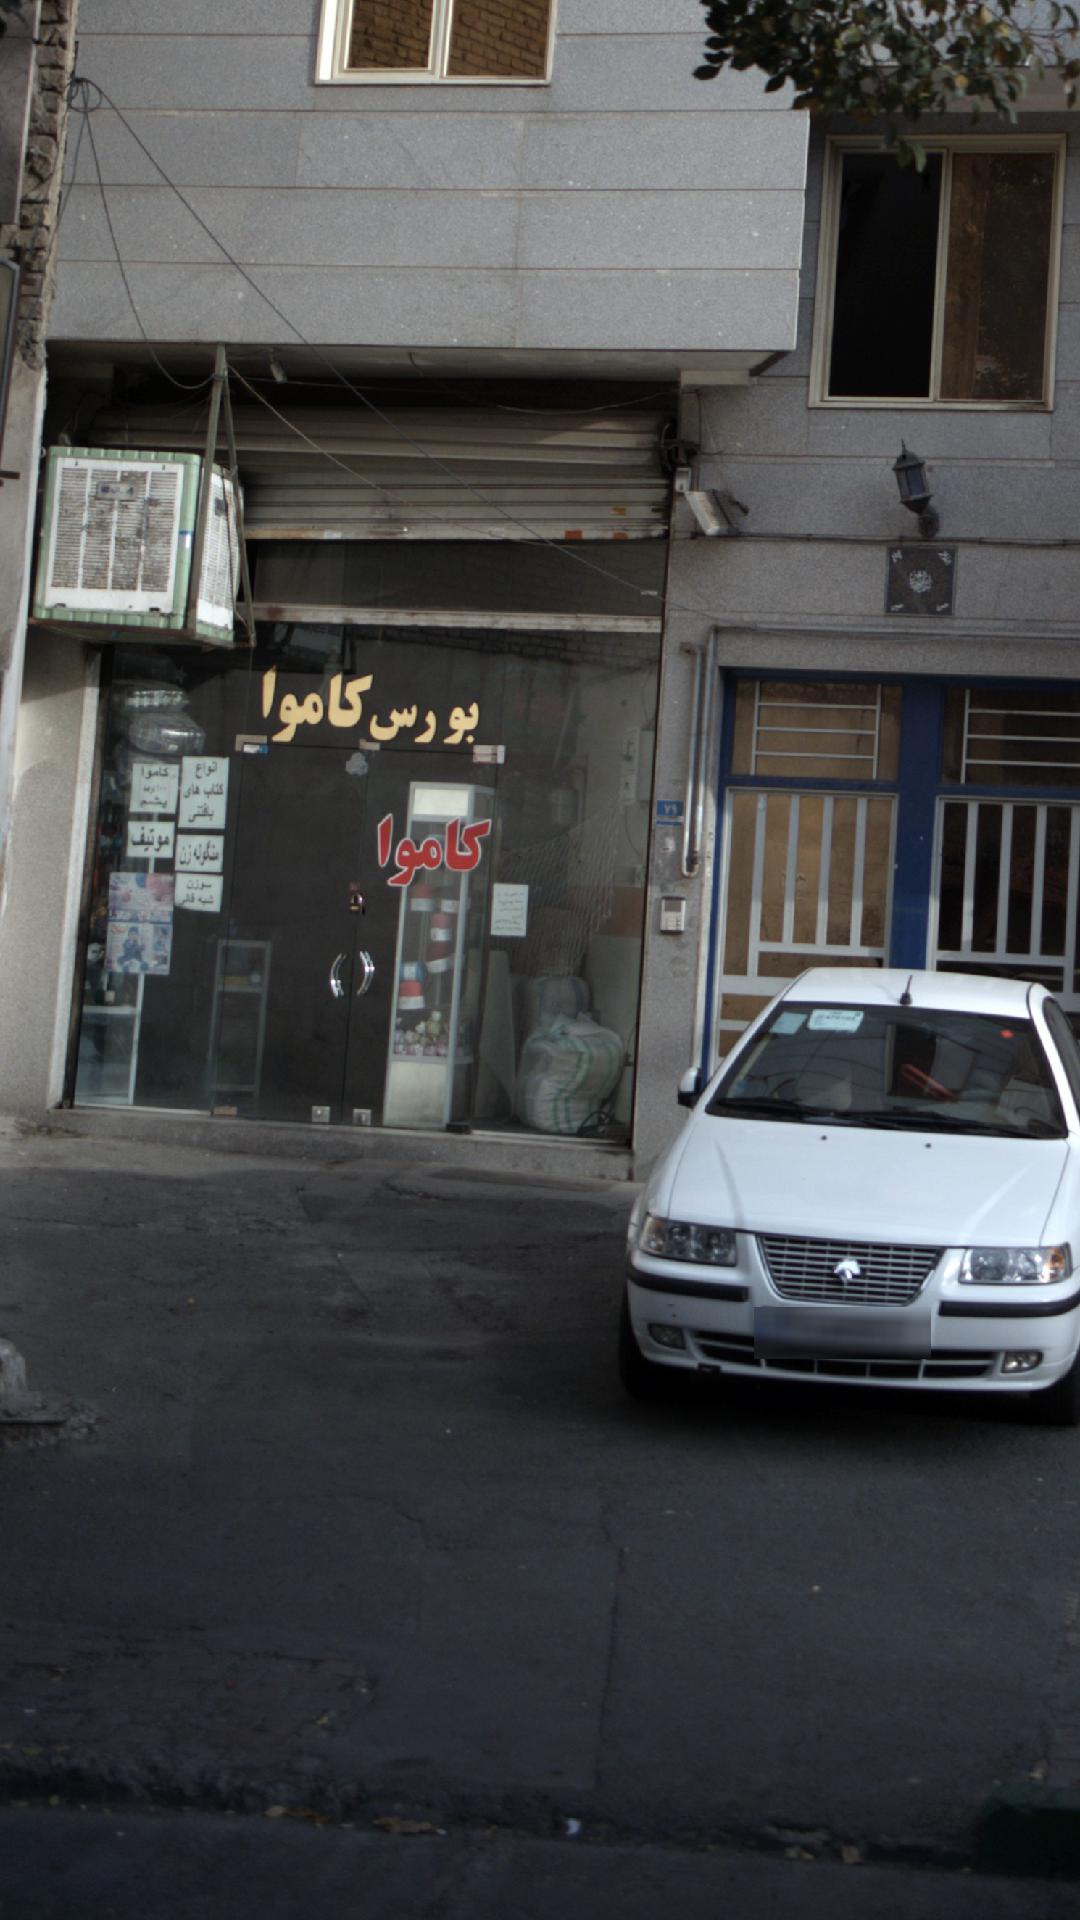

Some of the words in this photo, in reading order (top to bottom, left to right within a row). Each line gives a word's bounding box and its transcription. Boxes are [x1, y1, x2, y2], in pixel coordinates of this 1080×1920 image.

[262, 665, 374, 743] کاموا
[369, 702, 479, 744] بورس
[141, 765, 169, 779] کاموا
[195, 761, 218, 779] انواع
[183, 782, 200, 799] های
[203, 783, 224, 799] کتاب
[131, 826, 170, 853] موتیف
[377, 812, 492, 887] کاموا
